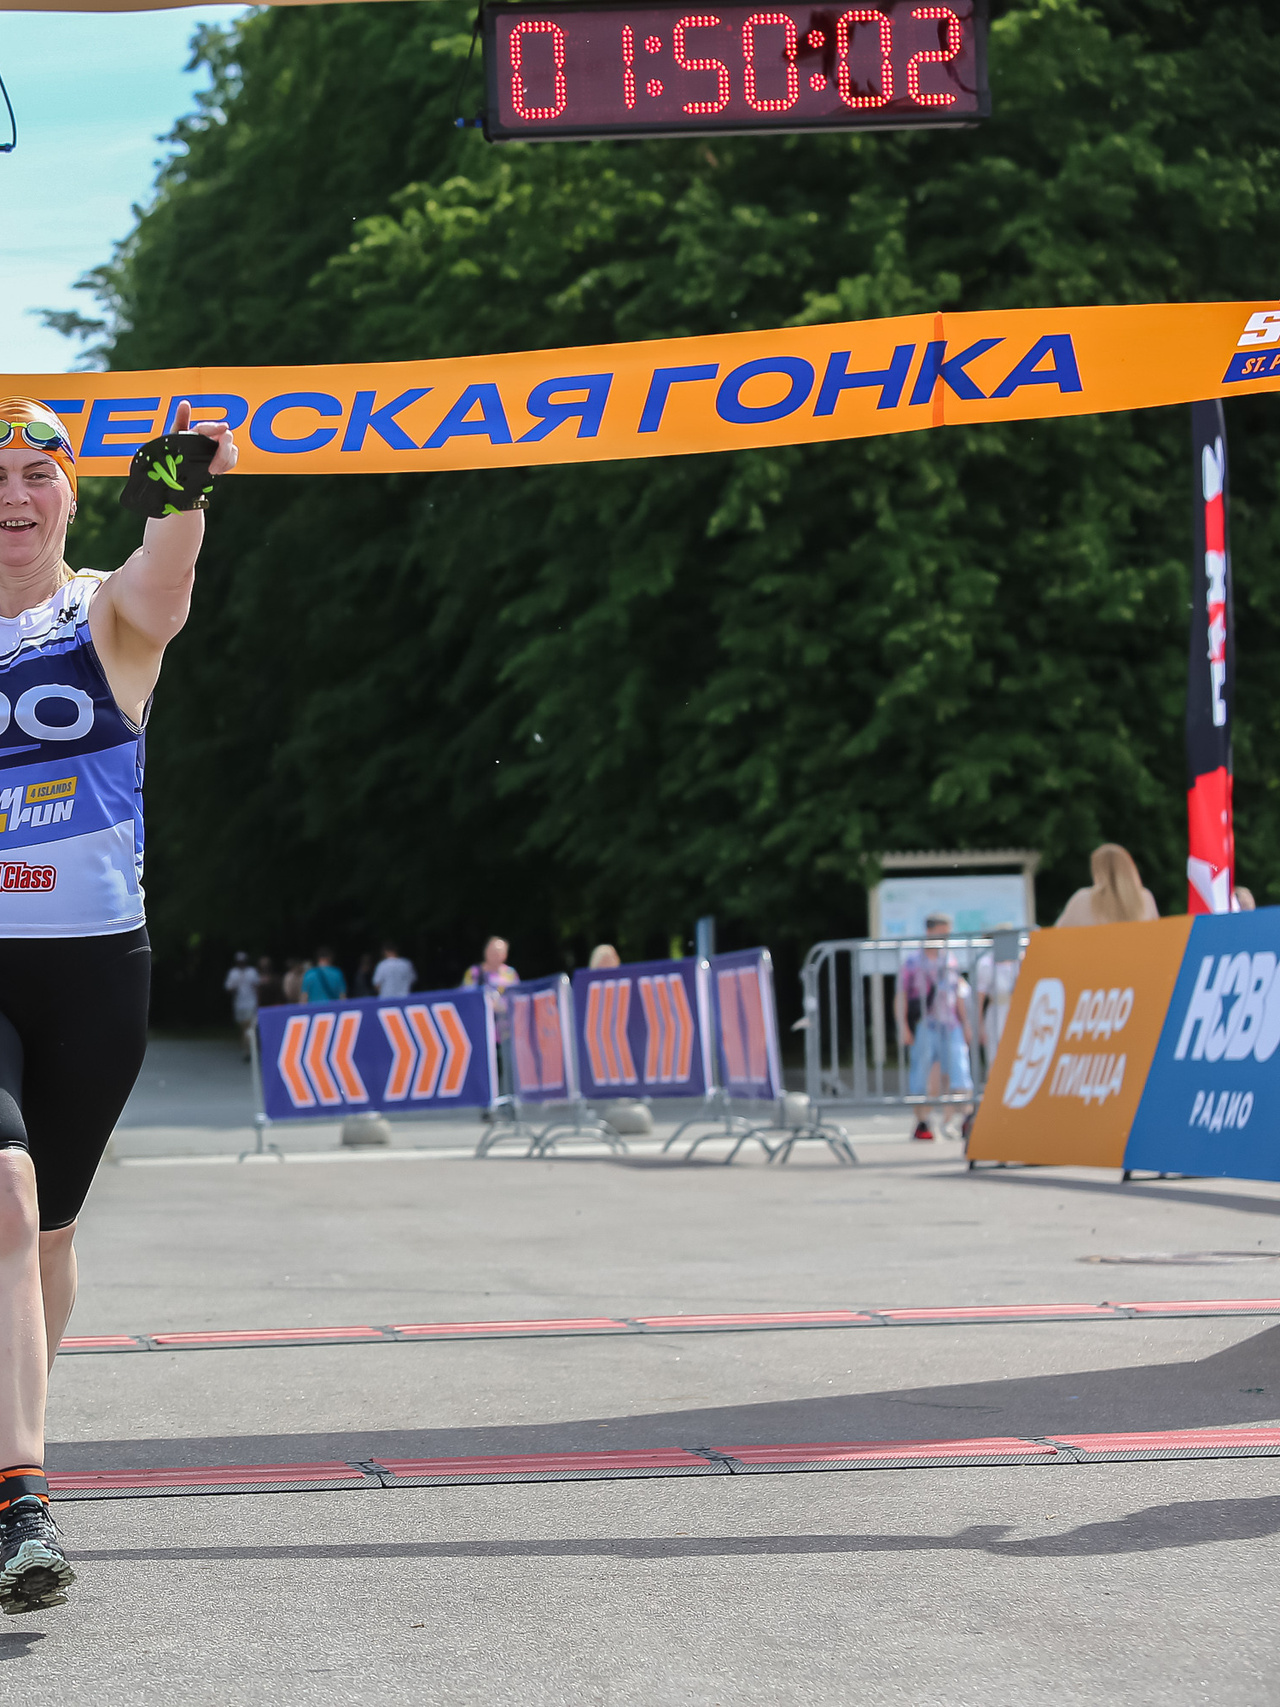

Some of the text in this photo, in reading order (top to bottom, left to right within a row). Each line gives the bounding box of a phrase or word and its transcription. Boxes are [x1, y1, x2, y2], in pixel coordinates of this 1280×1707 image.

[508, 7, 962, 121] 01:50:02
[636, 333, 1084, 433] ГОНКА
[30, 781, 73, 798] 4 ISLANDS
[2, 865, 52, 889] Class
[1064, 986, 1135, 1041] ДОДО
[1048, 1052, 1127, 1106] ПИЦЦА
[1188, 1089, 1255, 1134] РАДИО
